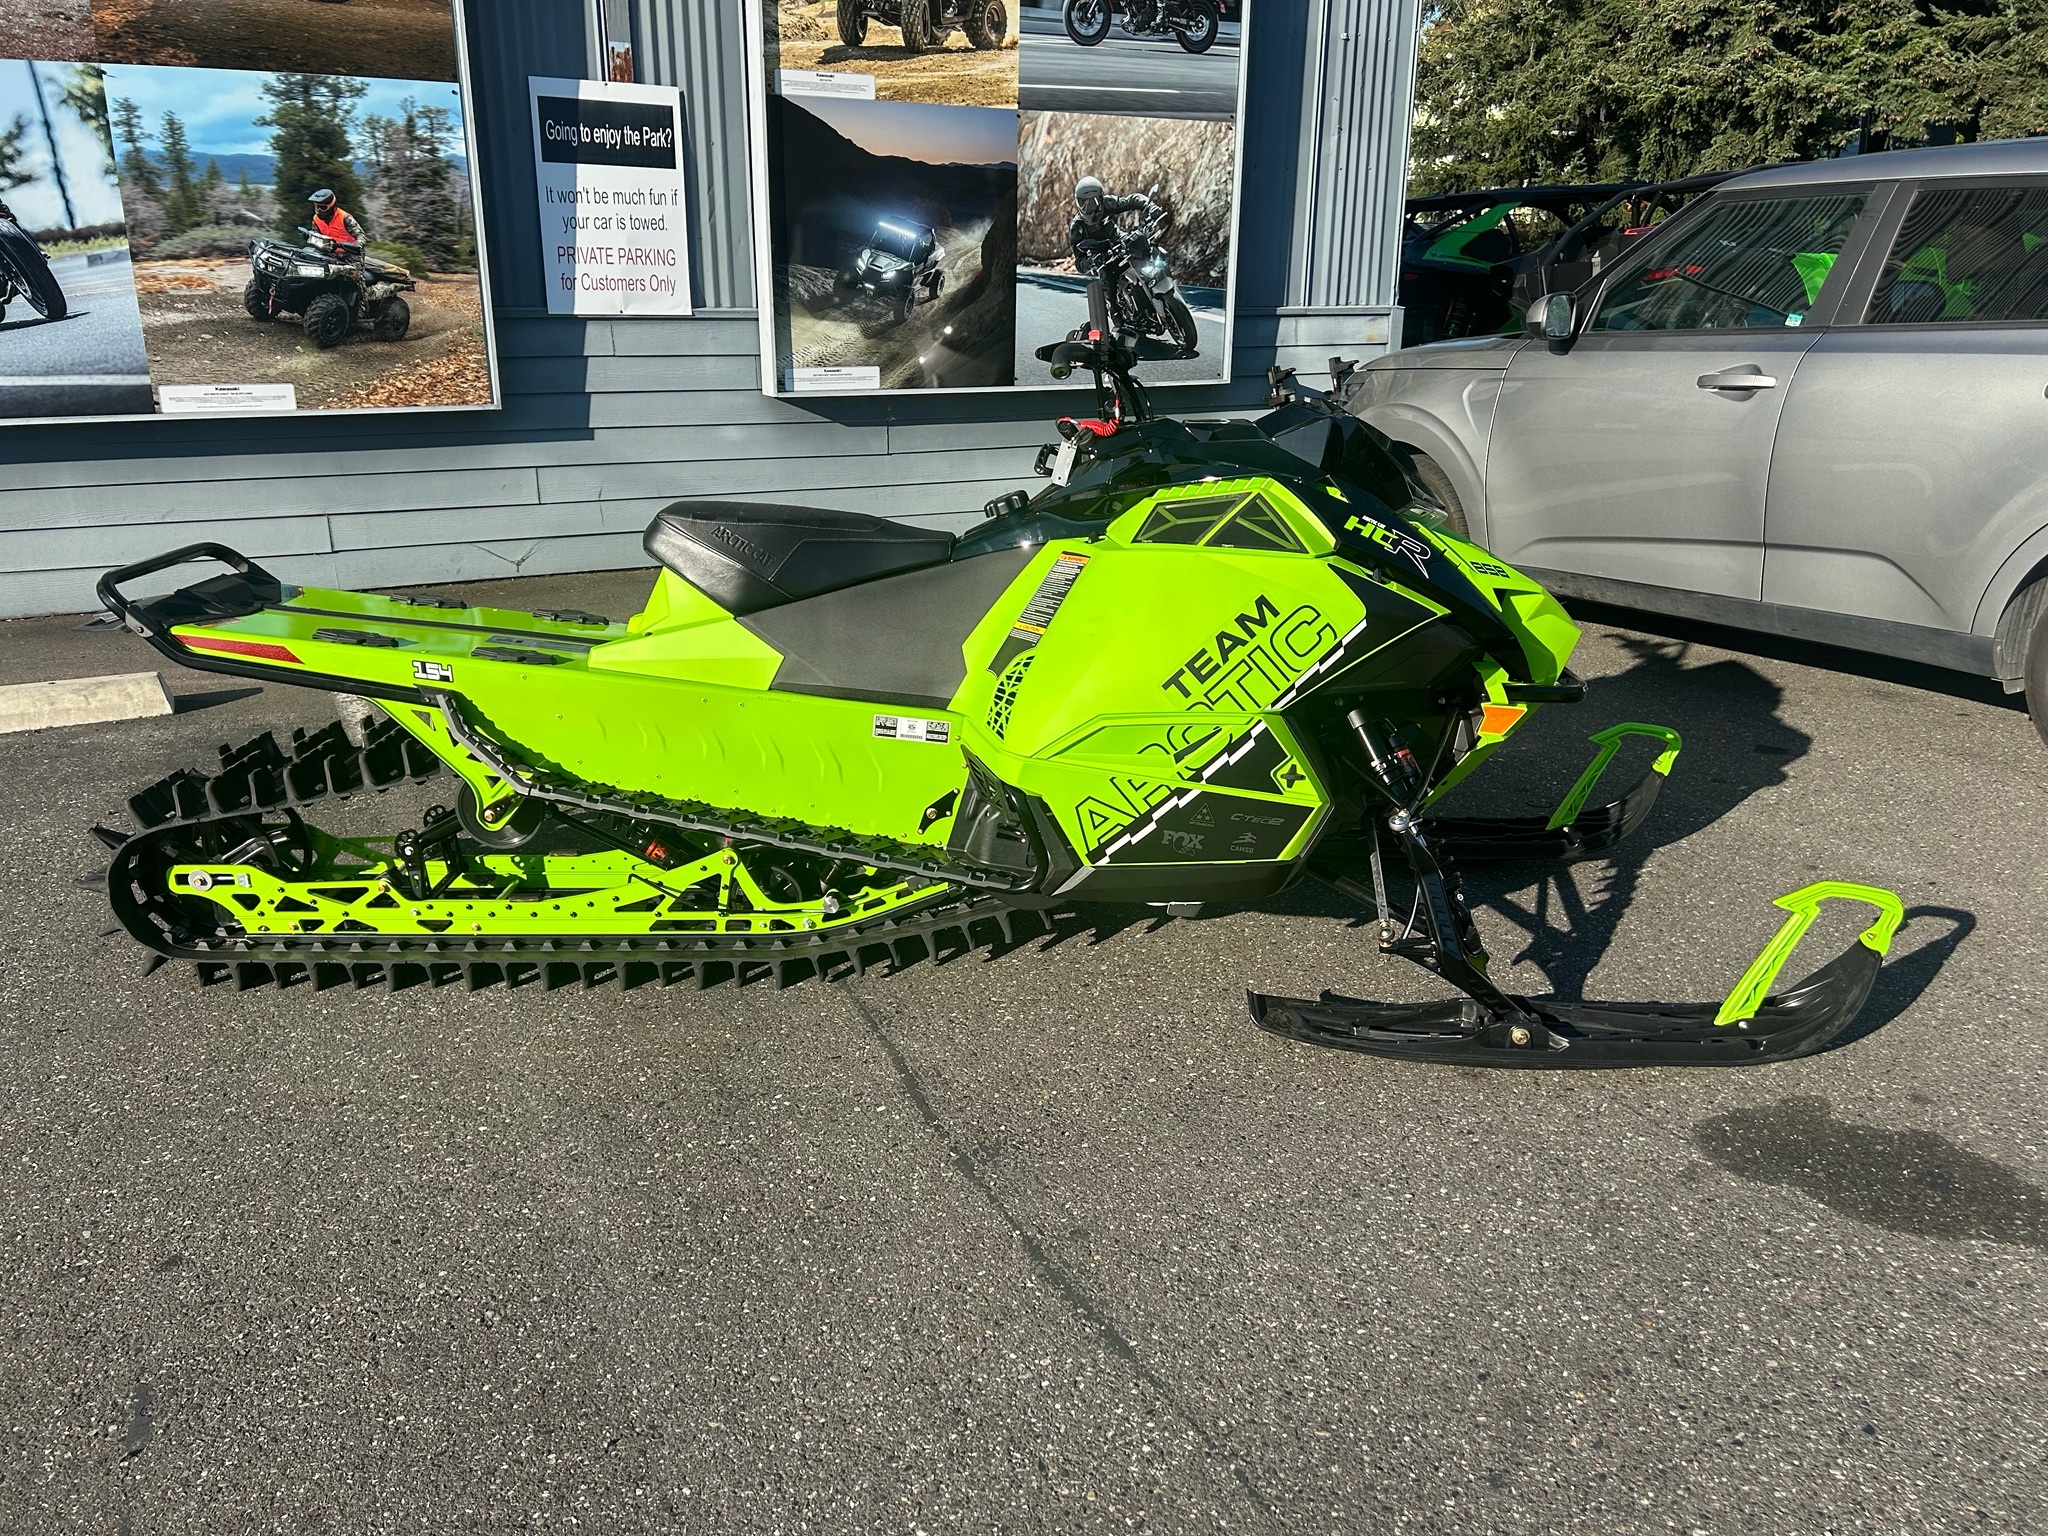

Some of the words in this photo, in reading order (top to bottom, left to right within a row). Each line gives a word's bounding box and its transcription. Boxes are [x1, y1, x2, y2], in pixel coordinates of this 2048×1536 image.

[545, 119, 578, 146] Going
[580, 122, 591, 143] to
[593, 123, 621, 150] enjoy
[623, 125, 641, 146] the
[642, 126, 672, 148] Park?
[545, 185, 555, 203] It
[557, 186, 590, 204] won't
[593, 186, 609, 205] be
[613, 188, 646, 205] much
[649, 188, 667, 206] fun
[670, 188, 678, 206] if
[562, 215, 589, 234] your
[593, 216, 613, 230] car
[616, 213, 627, 230] is
[629, 214, 668, 231] towed.
[557, 246, 614, 265] PRIVATE
[618, 247, 676, 267] PARKING
[561, 272, 577, 291] for
[581, 272, 646, 292] Customers
[649, 274, 677, 297] Only
[711, 525, 755, 555] ARCTIC
[751, 547, 777, 567] CAT
[1469, 561, 1511, 579] 858
[1161, 594, 1281, 700] TEAM
[412, 660, 454, 683] 154
[1161, 829, 1206, 856] FOX
[1230, 845, 1255, 854] CAMSO
